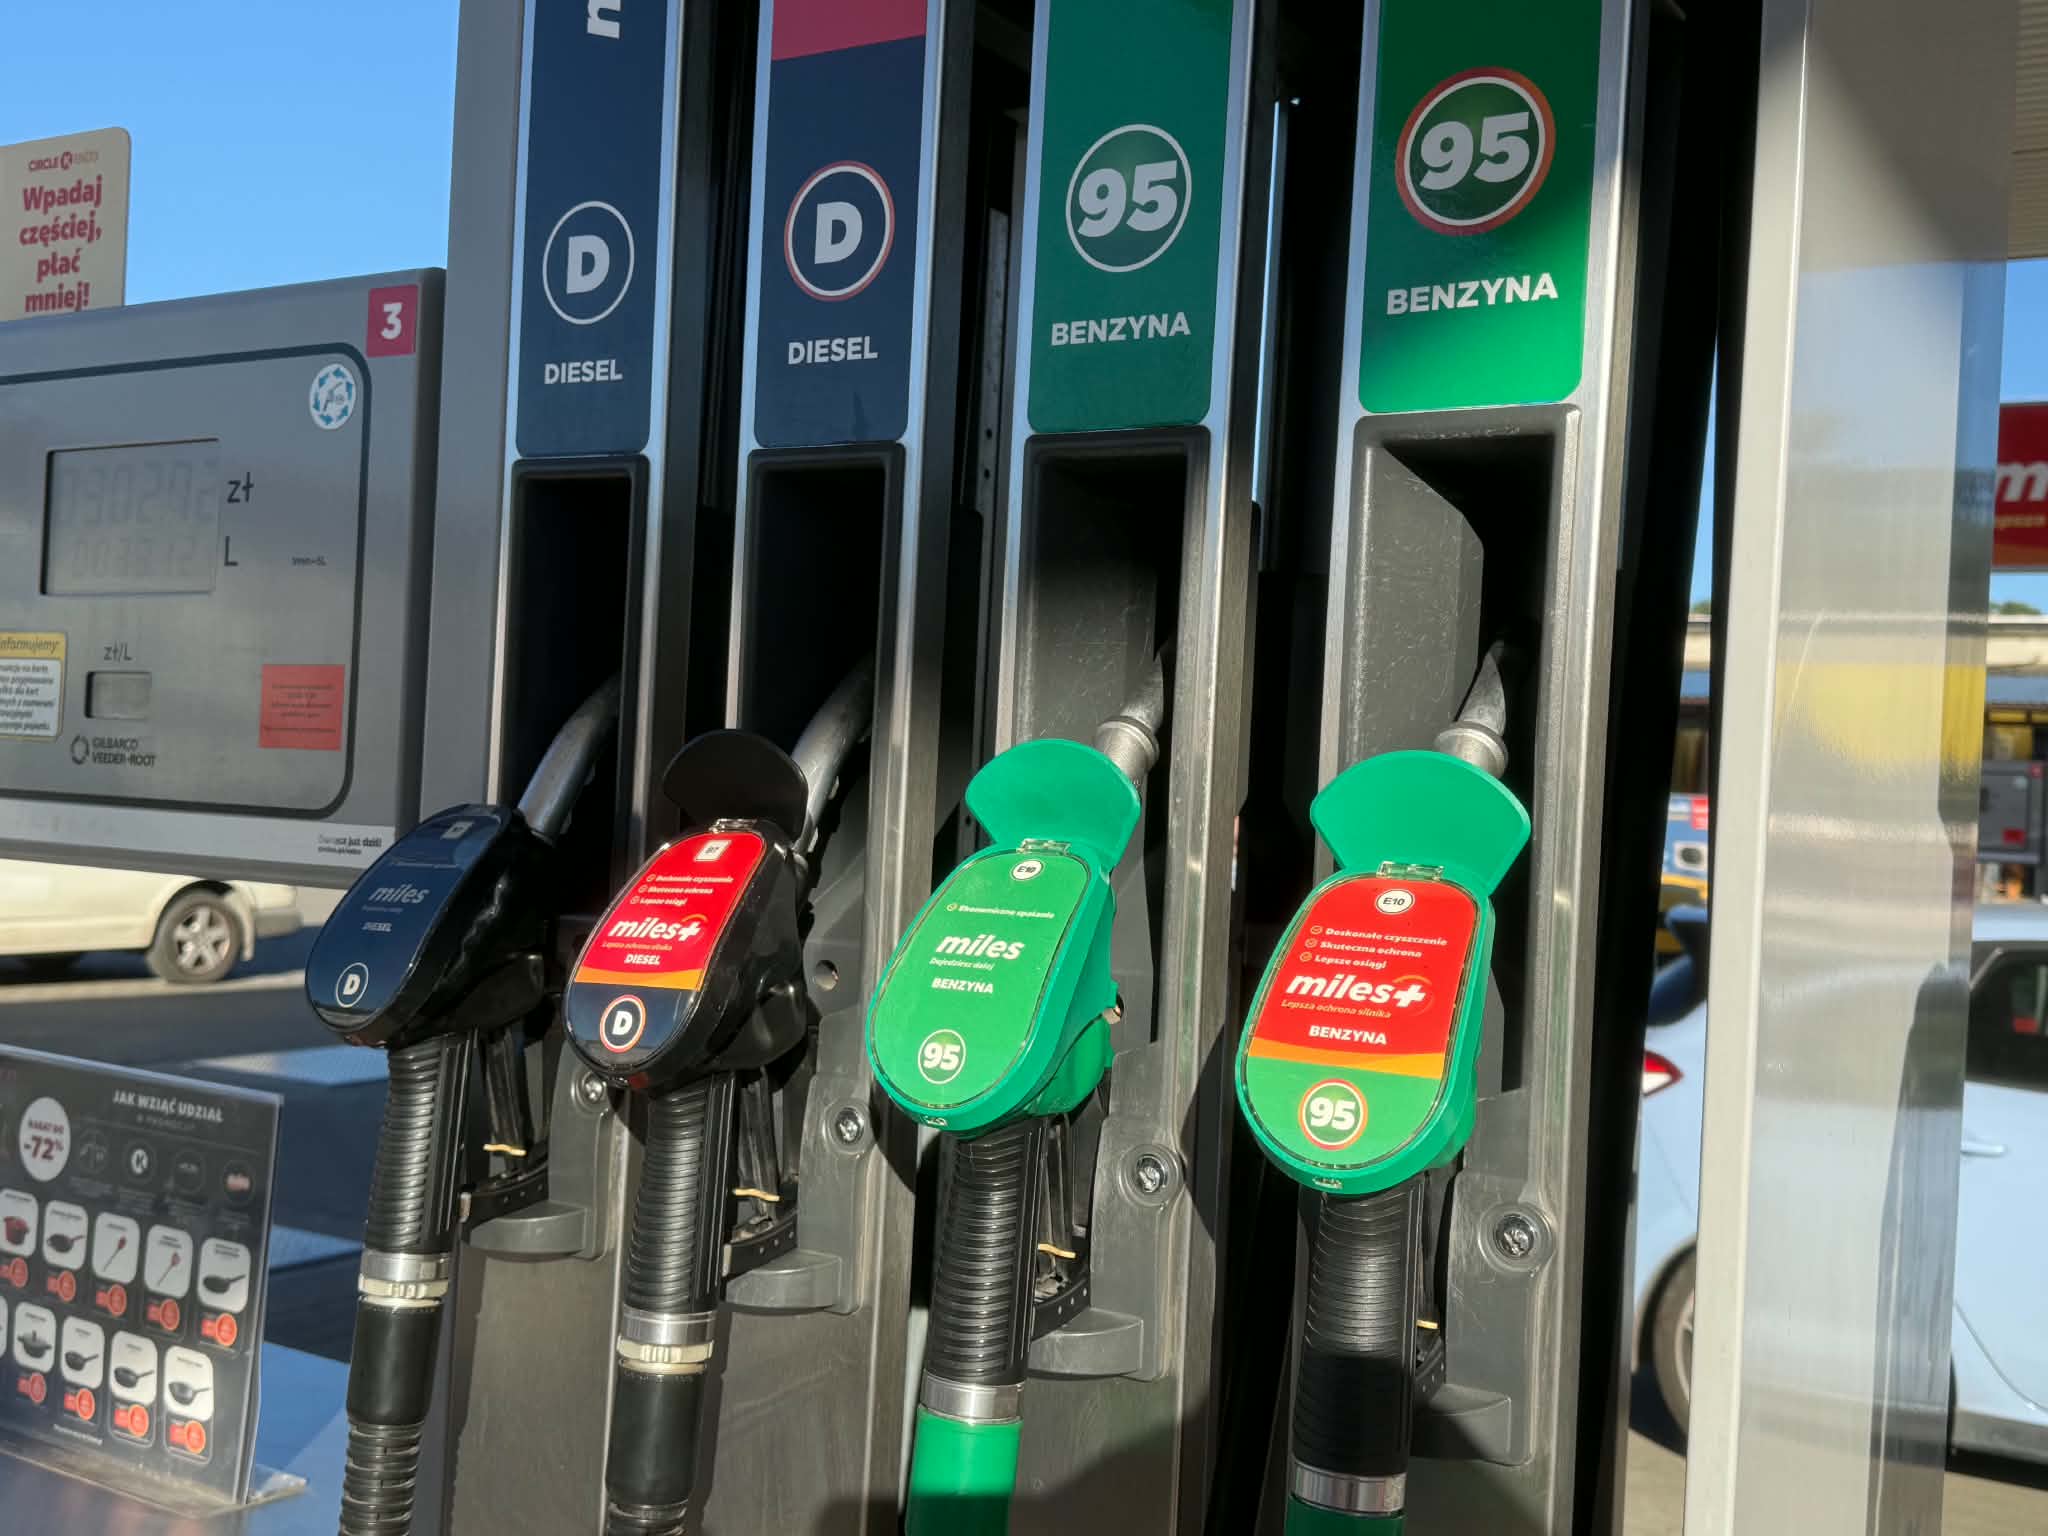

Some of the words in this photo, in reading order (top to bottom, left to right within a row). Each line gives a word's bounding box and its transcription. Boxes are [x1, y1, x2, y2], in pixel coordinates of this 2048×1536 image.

[28, 158, 59, 171] CIRCLE
[1419, 112, 1530, 190] 95
[22, 174, 103, 215] Wpadaj
[1077, 159, 1179, 237] 95
[18, 210, 102, 247] częściej,
[814, 201, 863, 264] D
[36, 248, 82, 283] płać
[566, 234, 610, 294] D
[24, 281, 90, 312] mniej!
[1387, 272, 1558, 315] BENZYNA
[380, 302, 403, 340] 3
[1051, 312, 1191, 346] BENZYNA
[788, 336, 878, 364] DIESEL
[544, 360, 623, 385] DIESEL
[227, 471, 254, 503] zł
[224, 536, 238, 566] L
[103, 641, 133, 663] zł/L
[92, 737, 138, 751] GILBARCO
[92, 752, 156, 768] VEEDER-ROOT
[368, 883, 430, 904] miles
[1382, 896, 1406, 906] E10
[608, 916, 701, 942] miles+
[1325, 927, 1382, 941] Doskonałe
[1383, 932, 1448, 946] czyszczenie
[624, 953, 661, 966] DIESEL
[936, 933, 1025, 960] miles
[1320, 940, 1376, 953] Skuteczna
[1377, 946, 1422, 958] ochrona
[1314, 954, 1351, 967] Lepsze
[1352, 959, 1388, 971] osiągi
[342, 973, 361, 995] D
[931, 977, 994, 994] BENZYNA
[1286, 972, 1426, 1008] miles+
[1281, 999, 1316, 1011] Lepsza
[1316, 1003, 1357, 1015] ochrona
[1357, 1007, 1393, 1018] silnika
[612, 1010, 633, 1036] D
[1308, 1024, 1388, 1046] BENZYNA
[922, 1042, 961, 1071] 95
[113, 1089, 136, 1107] JAK
[137, 1093, 177, 1116] WZIĄĆ
[178, 1101, 223, 1124] UDZIAŁ
[1309, 1096, 1357, 1132] 95
